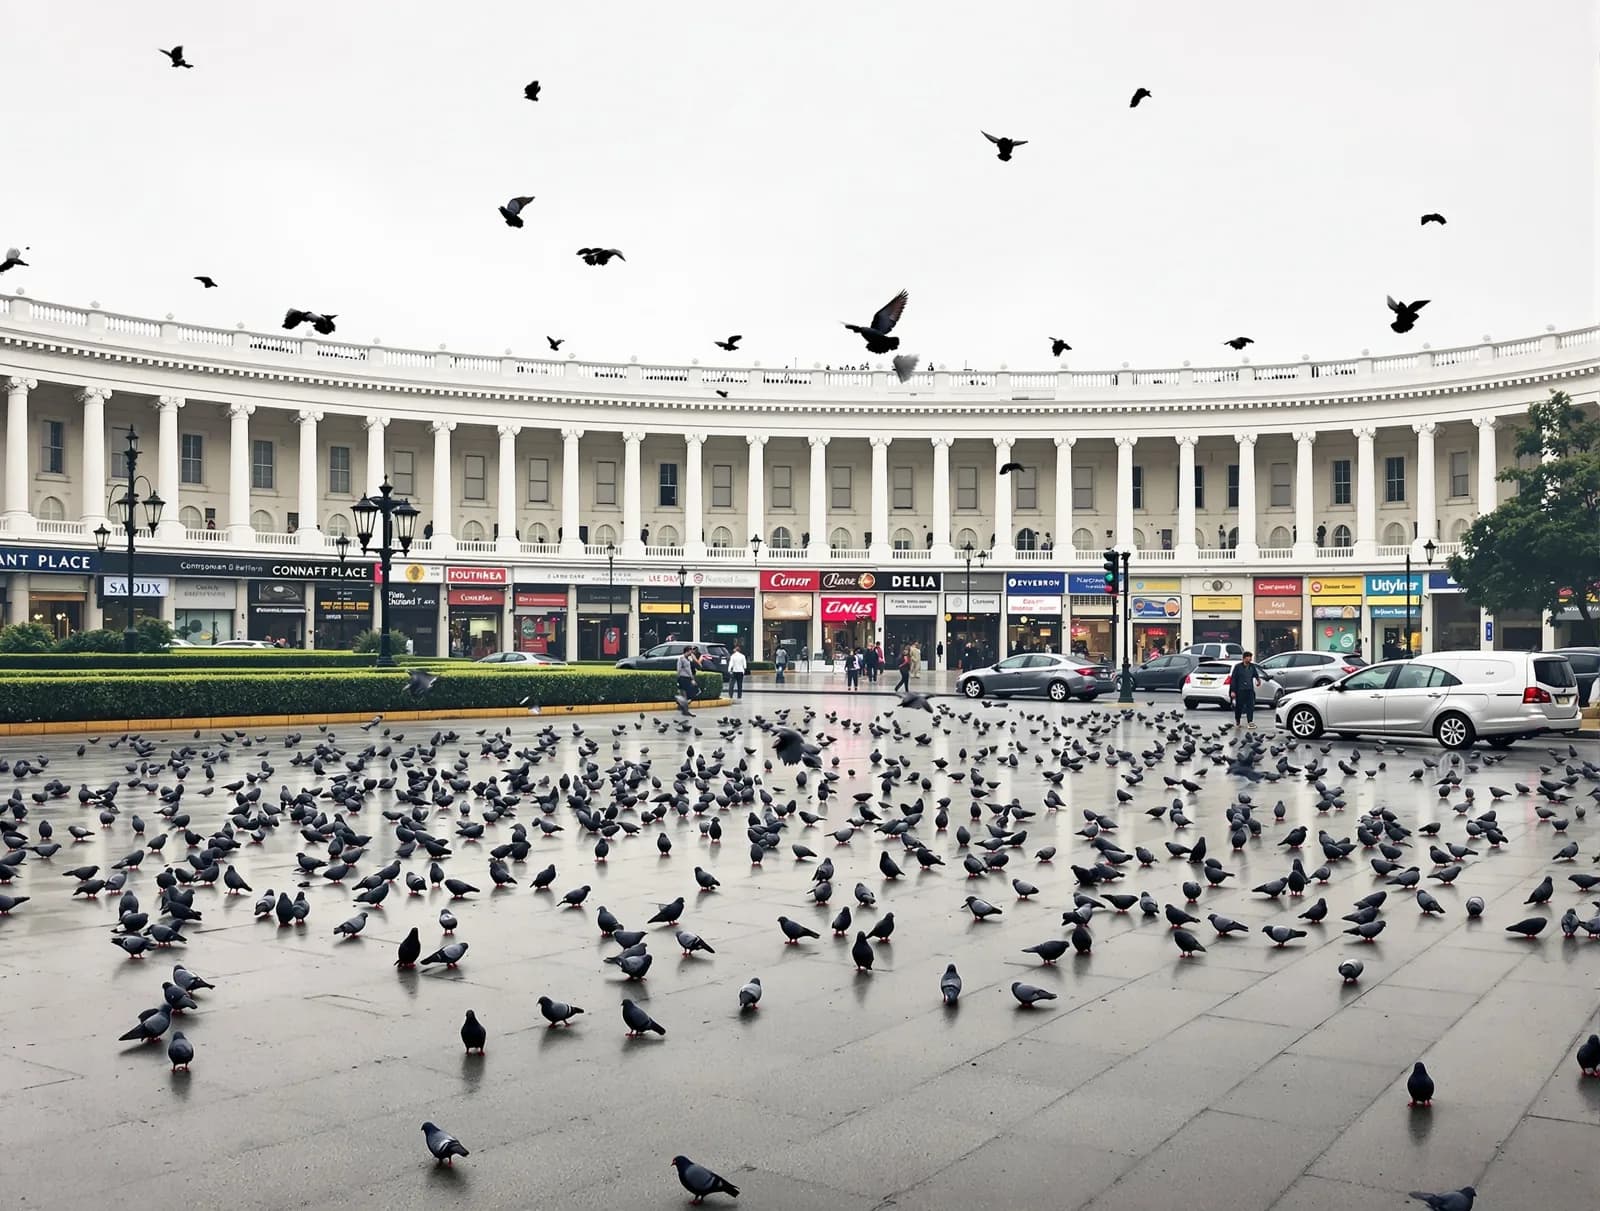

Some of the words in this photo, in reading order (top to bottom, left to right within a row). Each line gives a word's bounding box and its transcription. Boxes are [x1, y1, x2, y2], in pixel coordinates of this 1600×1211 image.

[38, 554, 91, 569] PLACE
[331, 567, 367, 577] PLACE
[892, 575, 936, 588] DELIA
